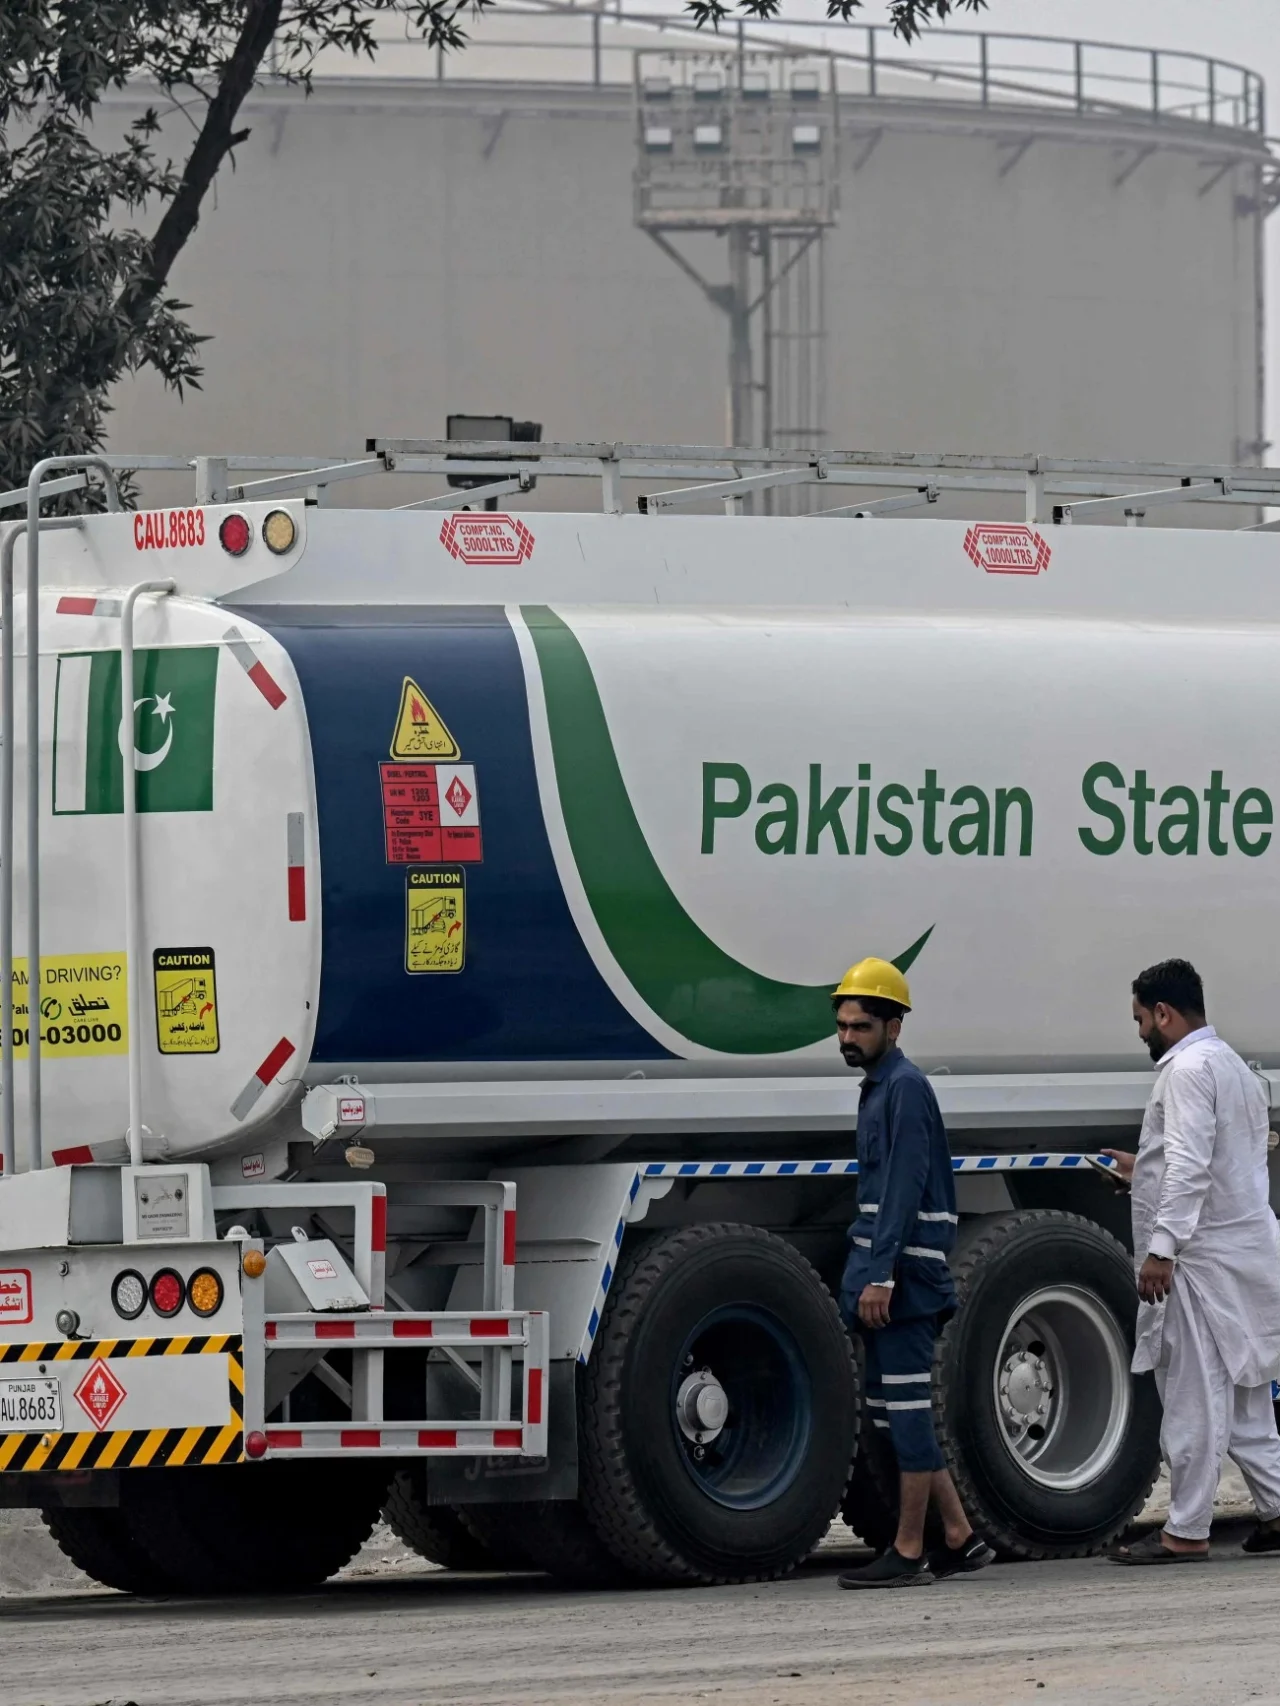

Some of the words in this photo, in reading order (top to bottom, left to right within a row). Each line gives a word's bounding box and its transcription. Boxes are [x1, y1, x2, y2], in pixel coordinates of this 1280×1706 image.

[134, 509, 205, 550] CAU.8683
[463, 537, 515, 552] 5000LTRS
[982, 534, 1028, 546] COMPT.NO.2
[986, 547, 1033, 564] 10000LTRS
[700, 762, 1034, 856] Pakistan
[1078, 760, 1274, 857] State
[411, 874, 460, 884] CAUTION
[158, 955, 210, 966] CAUTION
[46, 965, 122, 984] DRIVING?
[9, 1384, 35, 1392] PUNJAB
[98, 1409, 102, 1418] 3
